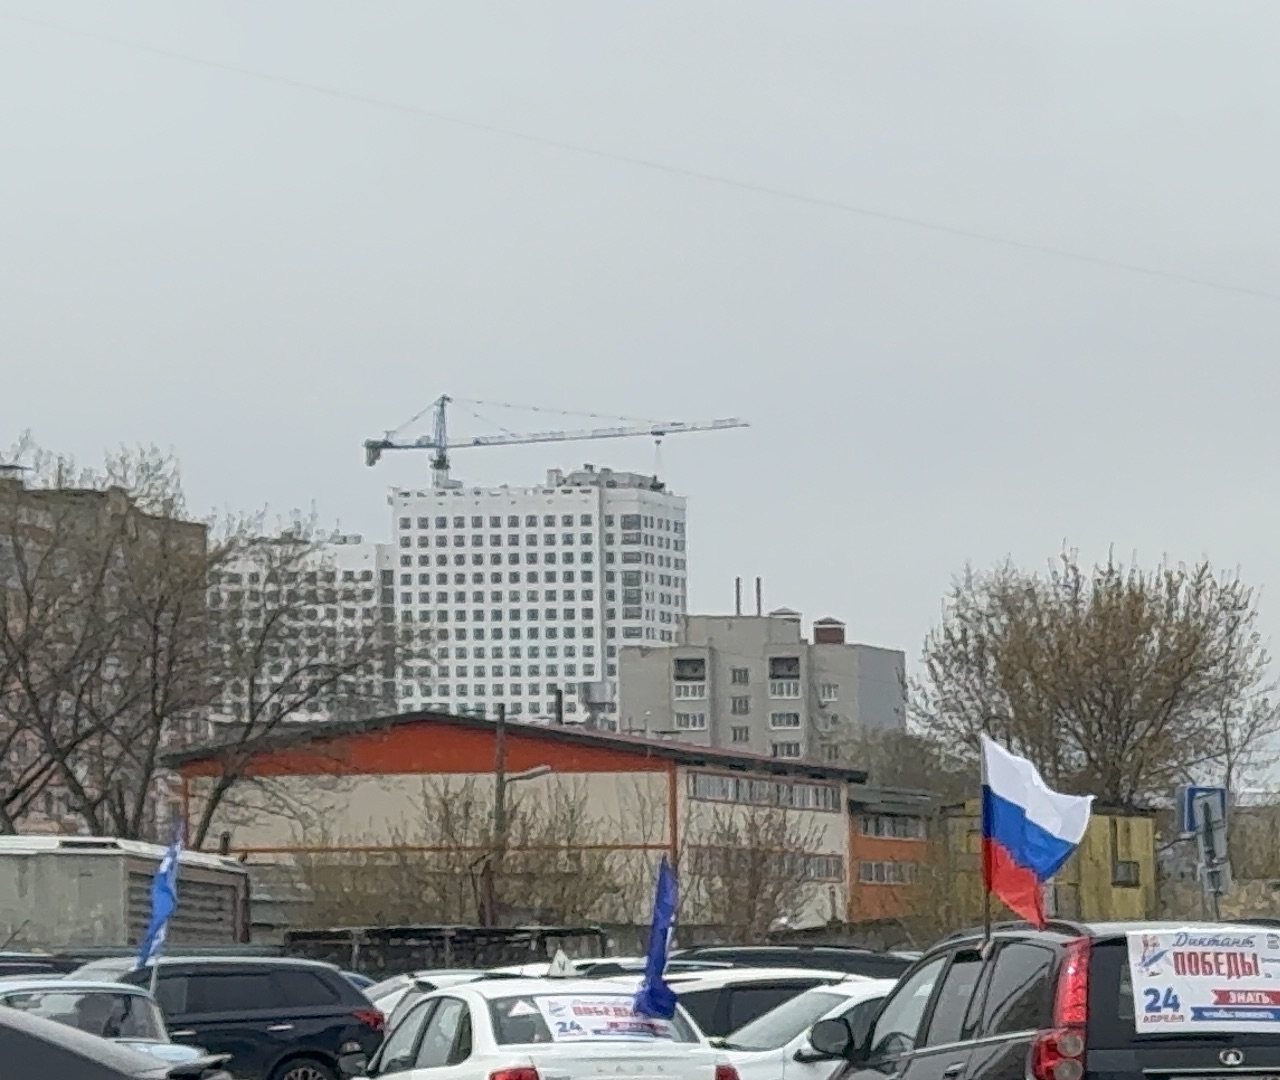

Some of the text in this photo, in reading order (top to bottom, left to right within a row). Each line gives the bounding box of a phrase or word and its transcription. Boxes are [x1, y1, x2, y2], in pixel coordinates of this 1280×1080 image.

[1172, 932, 1256, 948] Диктант
[1173, 951, 1260, 980] ПОБЕДЫ
[1143, 987, 1181, 1014] 24
